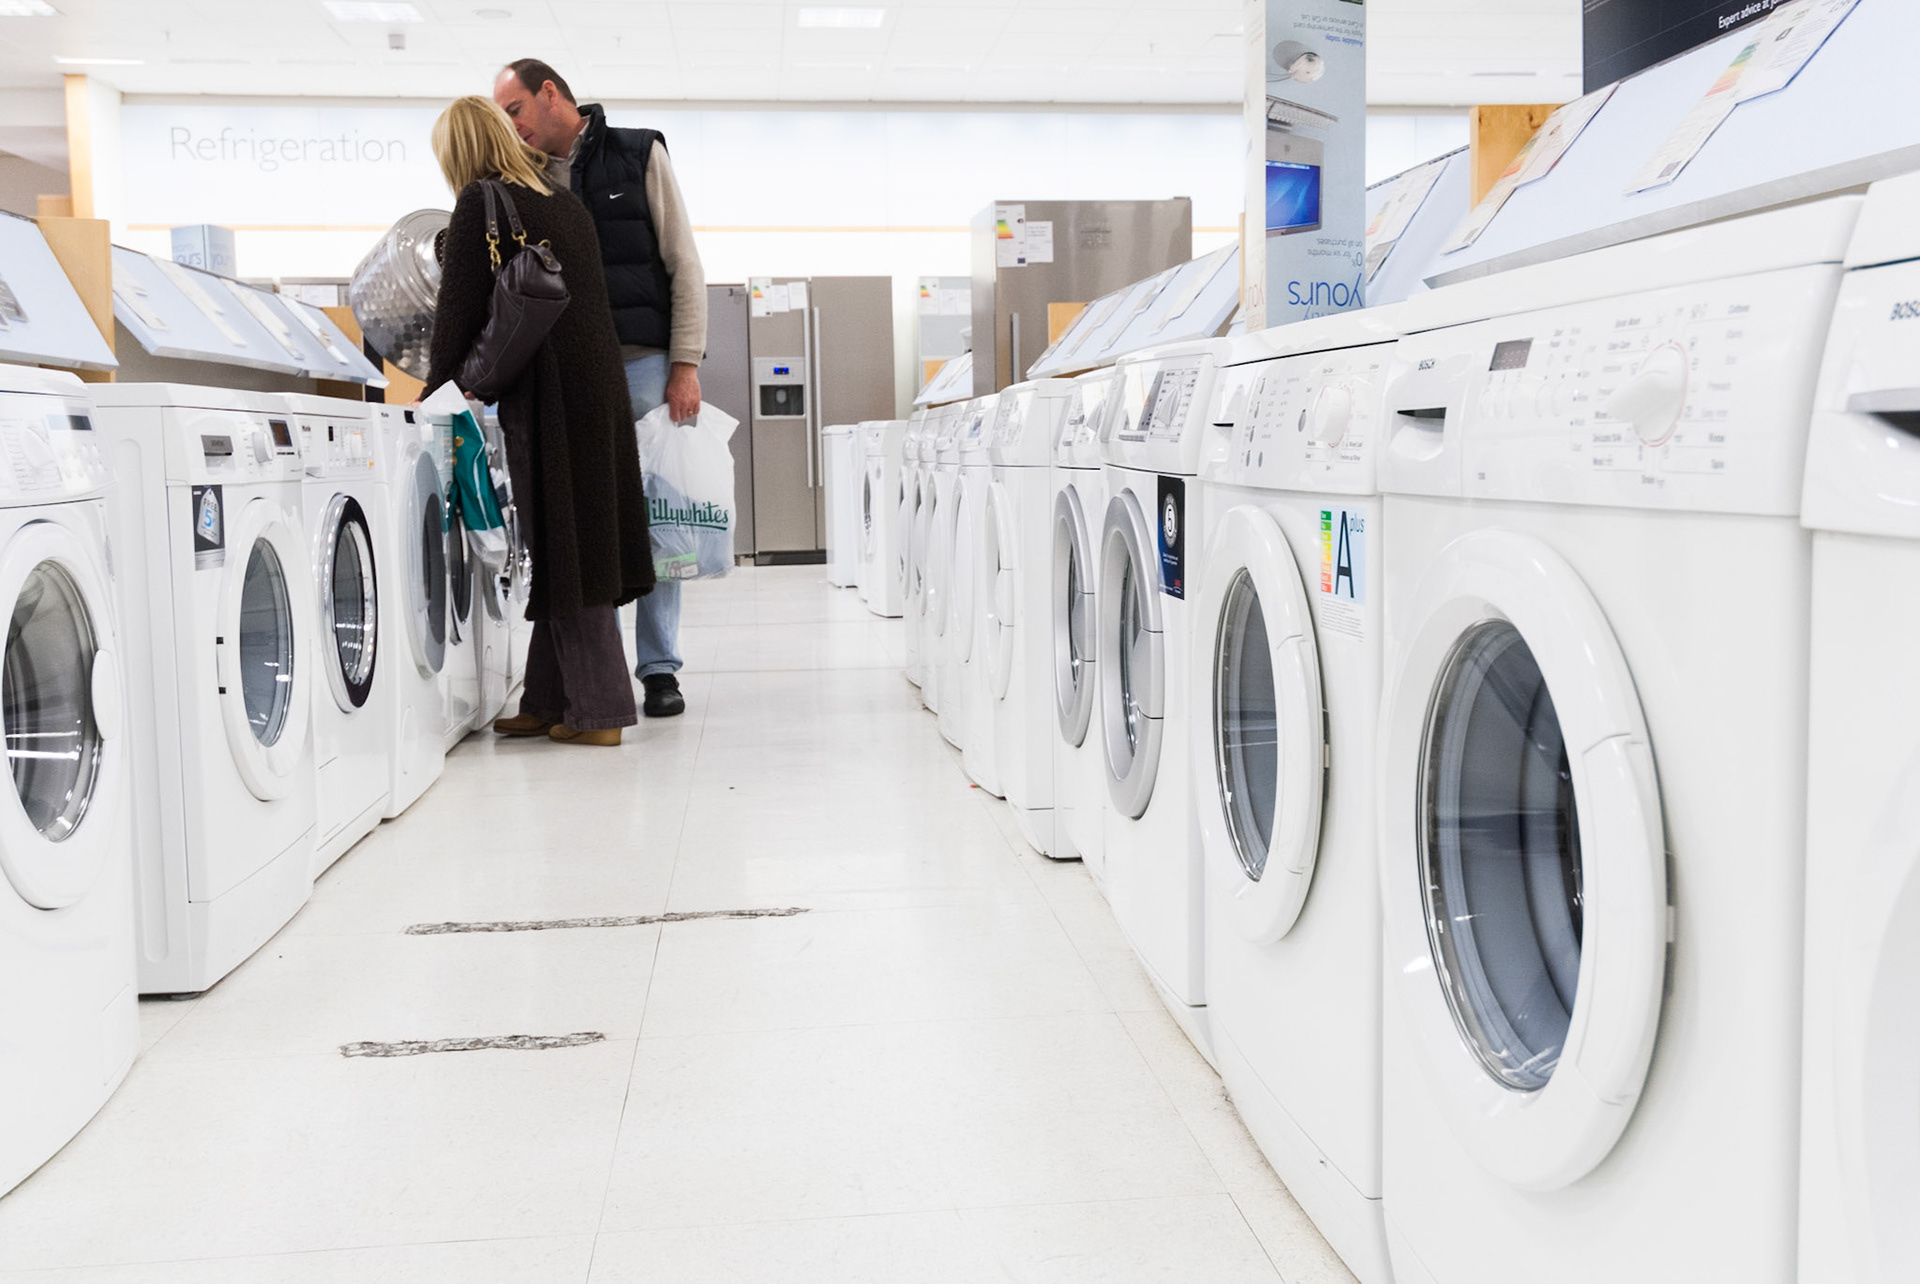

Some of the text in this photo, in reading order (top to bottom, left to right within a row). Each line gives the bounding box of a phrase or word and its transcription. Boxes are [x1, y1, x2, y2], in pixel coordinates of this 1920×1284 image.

[1718, 11, 1741, 29] Expert
[1740, 1, 1762, 20] advice
[1324, 33, 1364, 47] Available today
[170, 126, 407, 172] Refrigeration
[1306, 248, 1332, 257] months
[1342, 250, 1351, 259] for
[1287, 272, 1363, 308] yours
[203, 508, 213, 528] 5
[1167, 508, 1174, 533] 5
[1335, 510, 1365, 599] A plus
